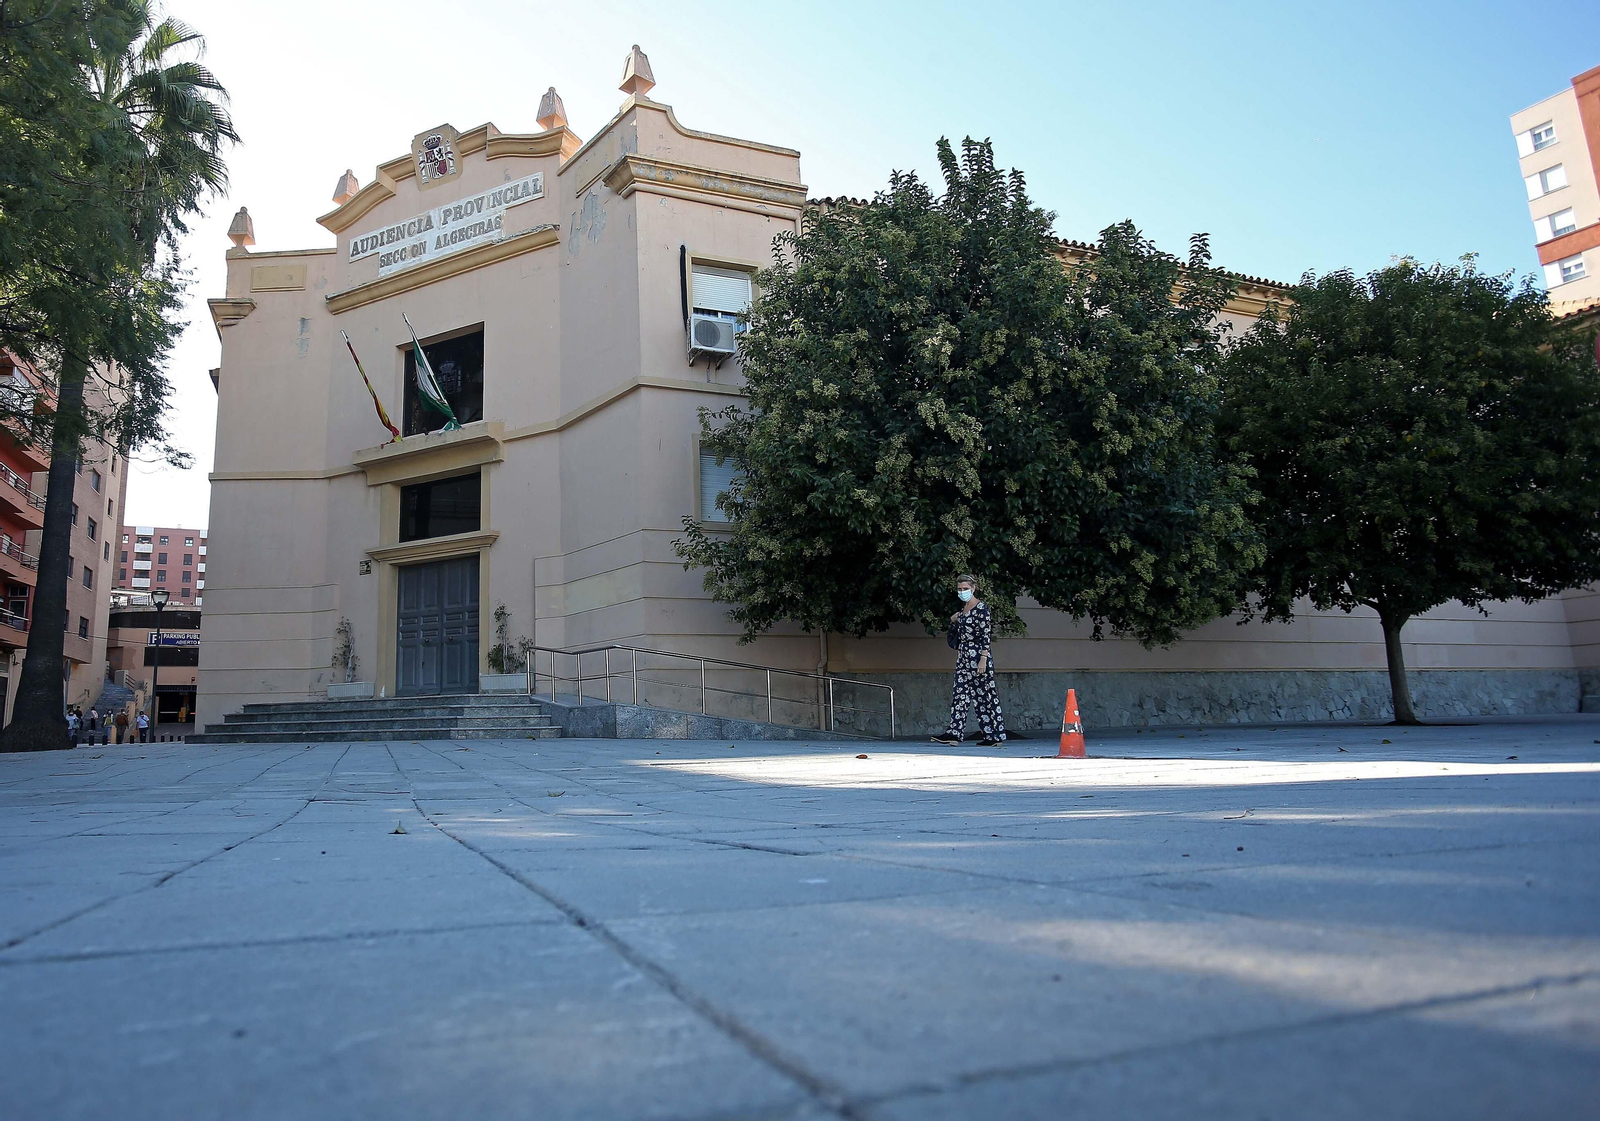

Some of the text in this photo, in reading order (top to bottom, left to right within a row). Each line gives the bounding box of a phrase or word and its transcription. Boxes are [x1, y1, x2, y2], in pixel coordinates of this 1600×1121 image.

[350, 177, 542, 257] AUDIENCIA PROVINCIAL
[379, 214, 502, 268] SECCON ALGECIRAS
